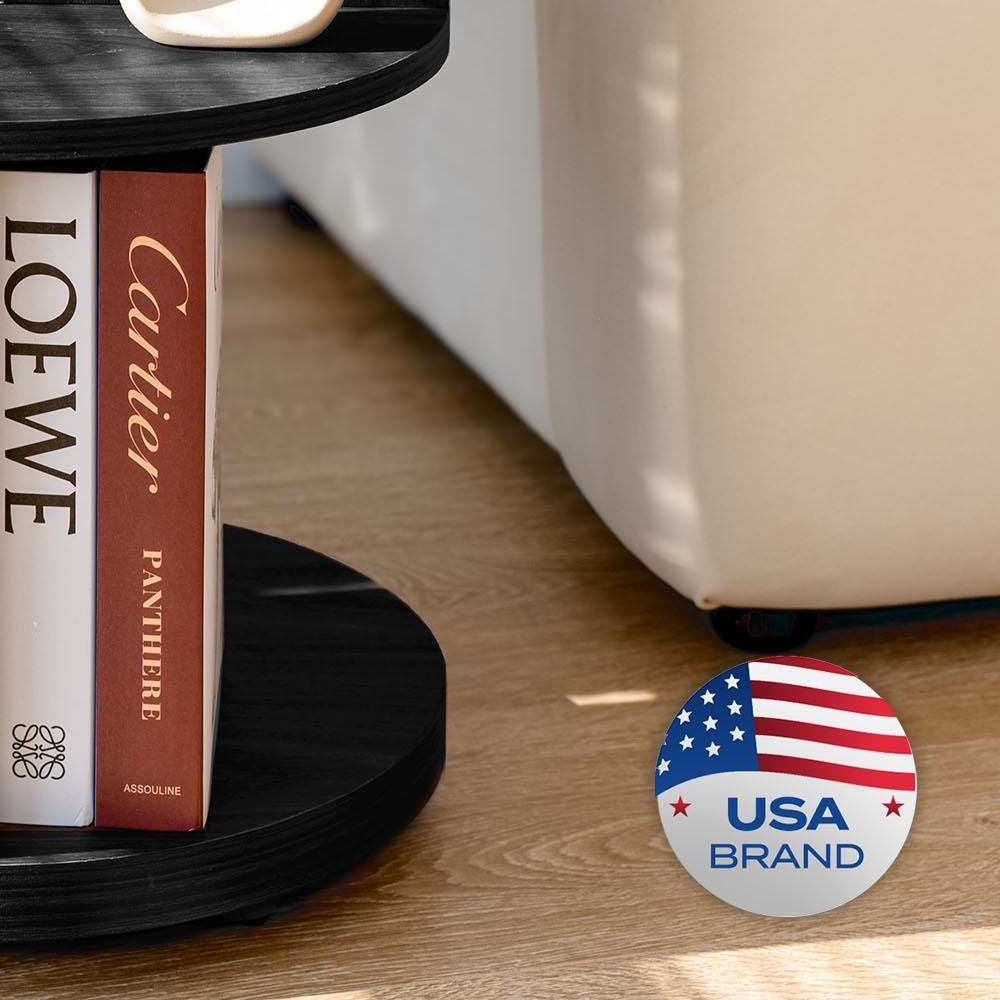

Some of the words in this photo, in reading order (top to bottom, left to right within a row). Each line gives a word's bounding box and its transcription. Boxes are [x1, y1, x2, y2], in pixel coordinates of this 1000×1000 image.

[4, 215, 77, 535] LOEWE
[127, 235, 190, 494] Cartier
[141, 549, 163, 721] PANTHERE
[123, 783, 181, 796] ASSOULINE
